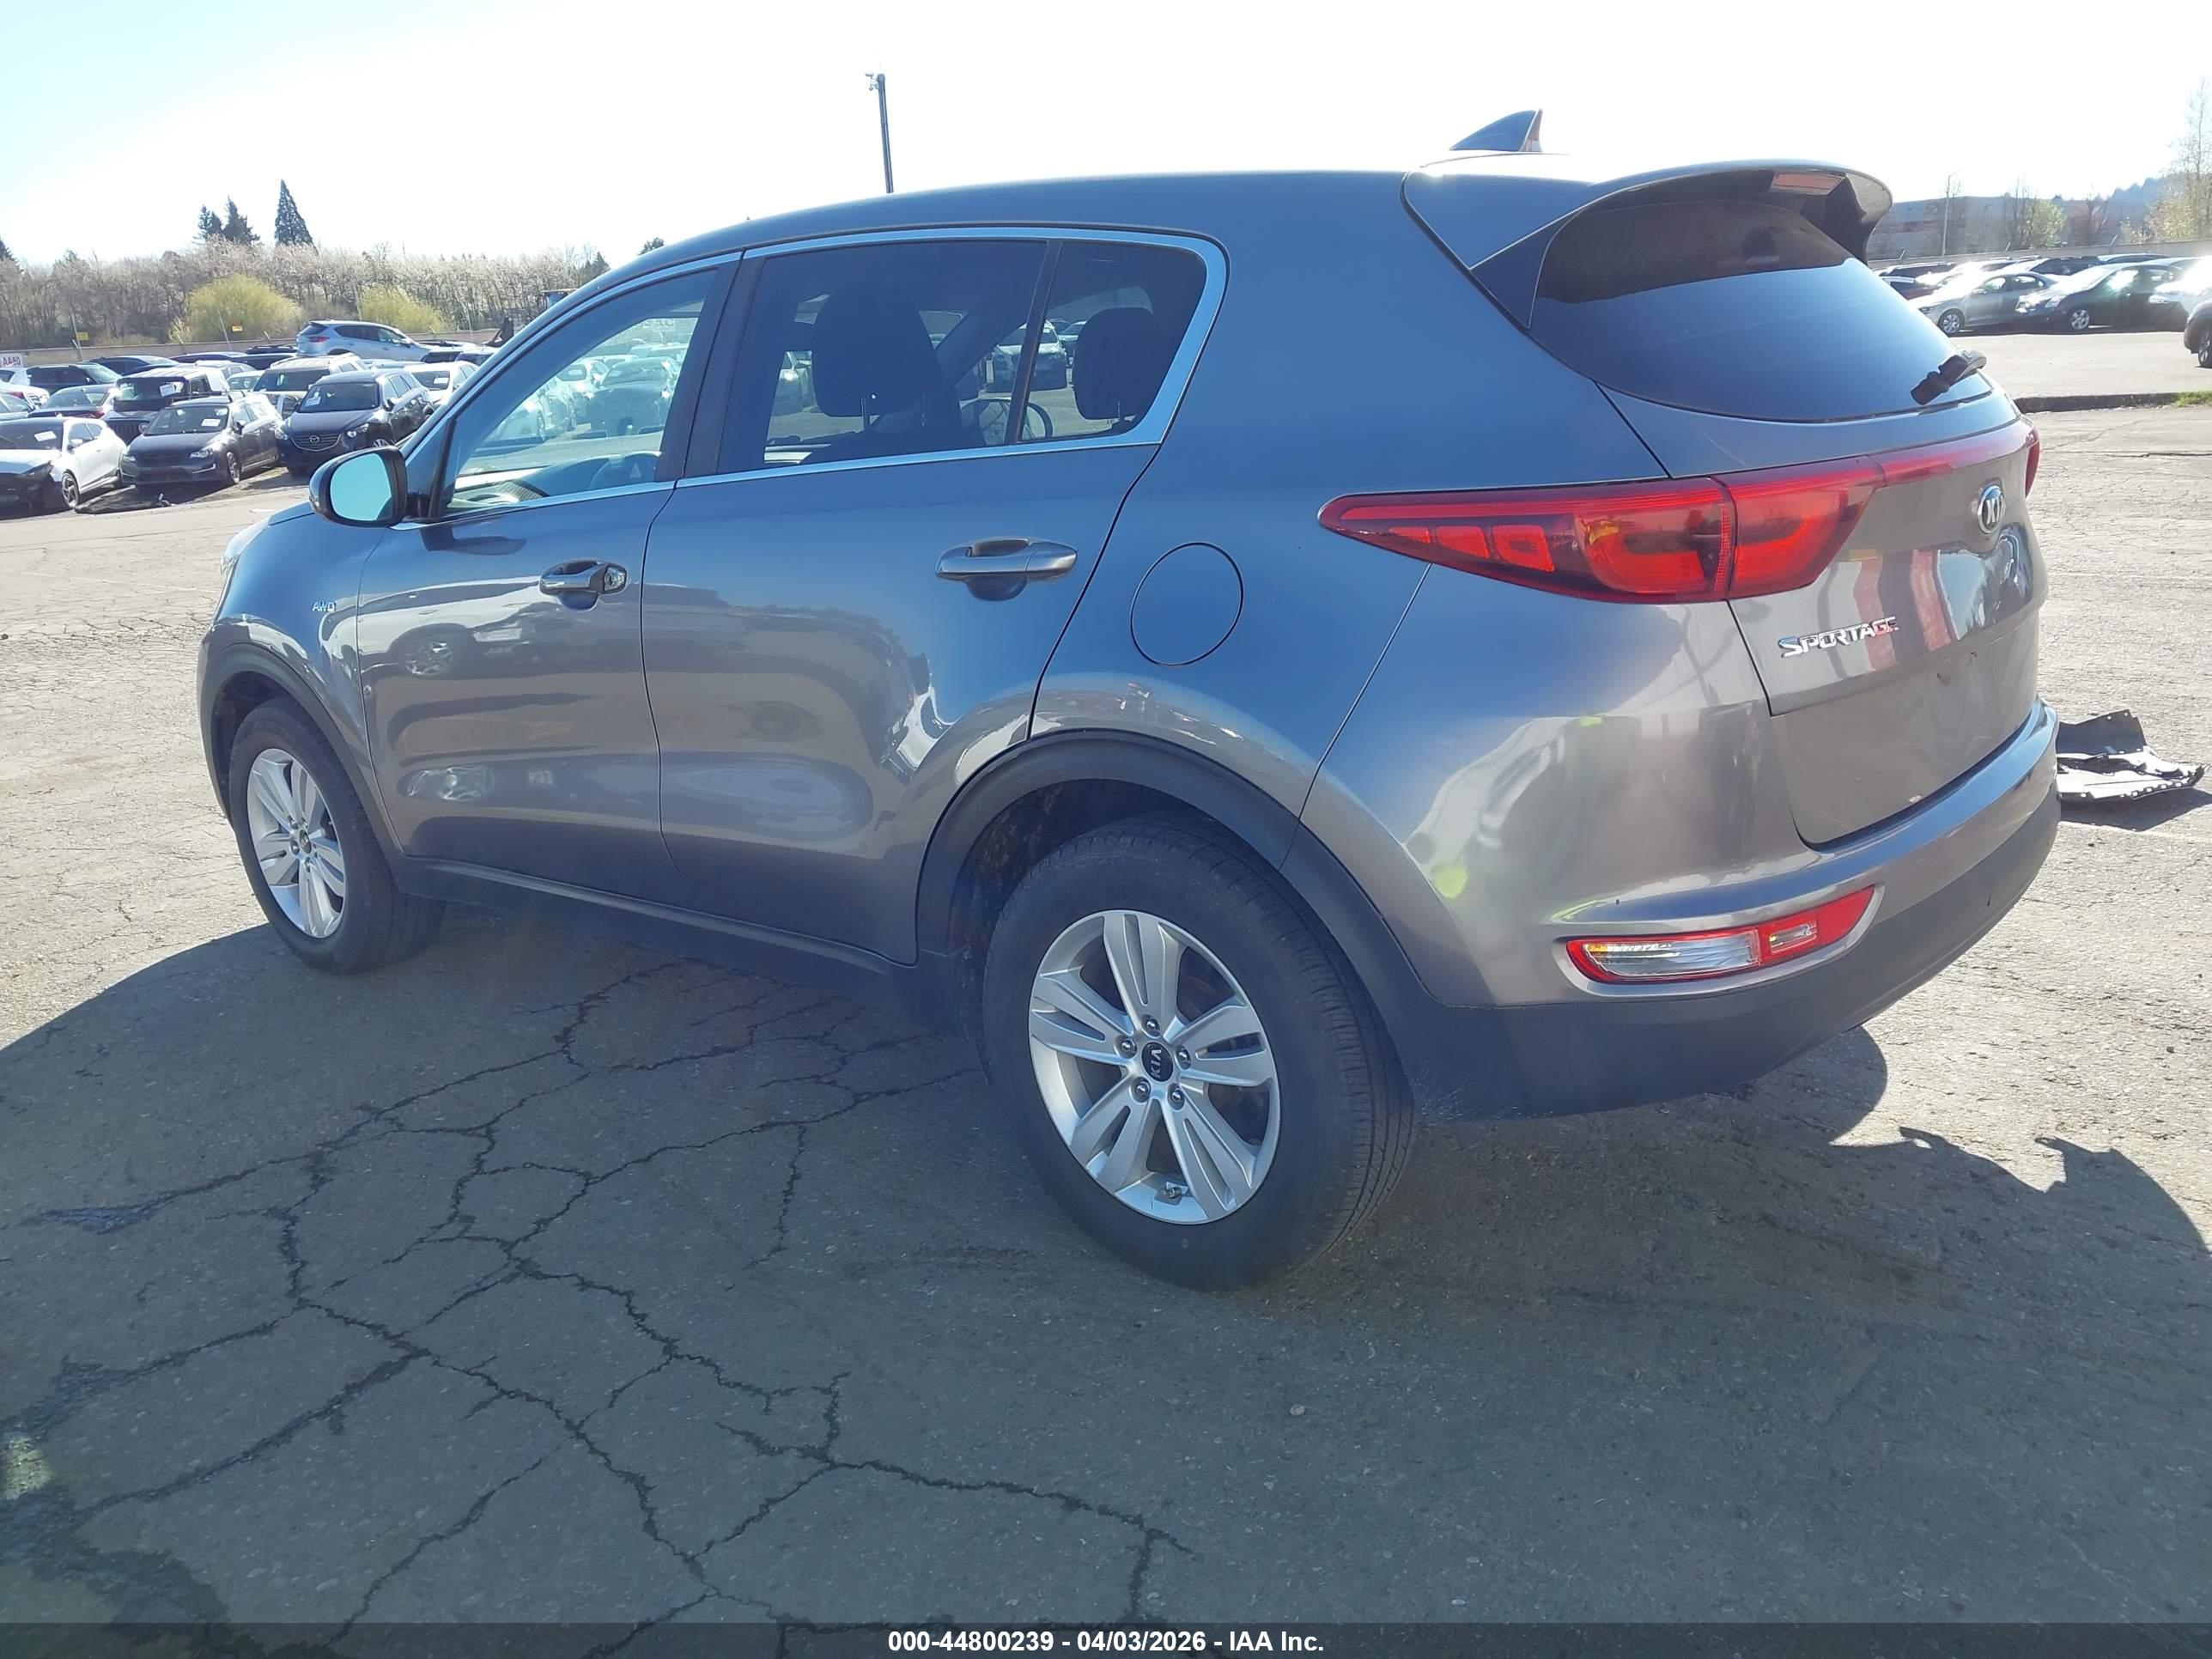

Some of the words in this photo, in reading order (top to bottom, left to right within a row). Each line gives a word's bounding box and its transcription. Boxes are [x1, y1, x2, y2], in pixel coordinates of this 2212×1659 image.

[312, 601, 336, 612] AWD
[1778, 616, 1899, 658] SPORTAGE
[1151, 1049, 1162, 1079] KIA
